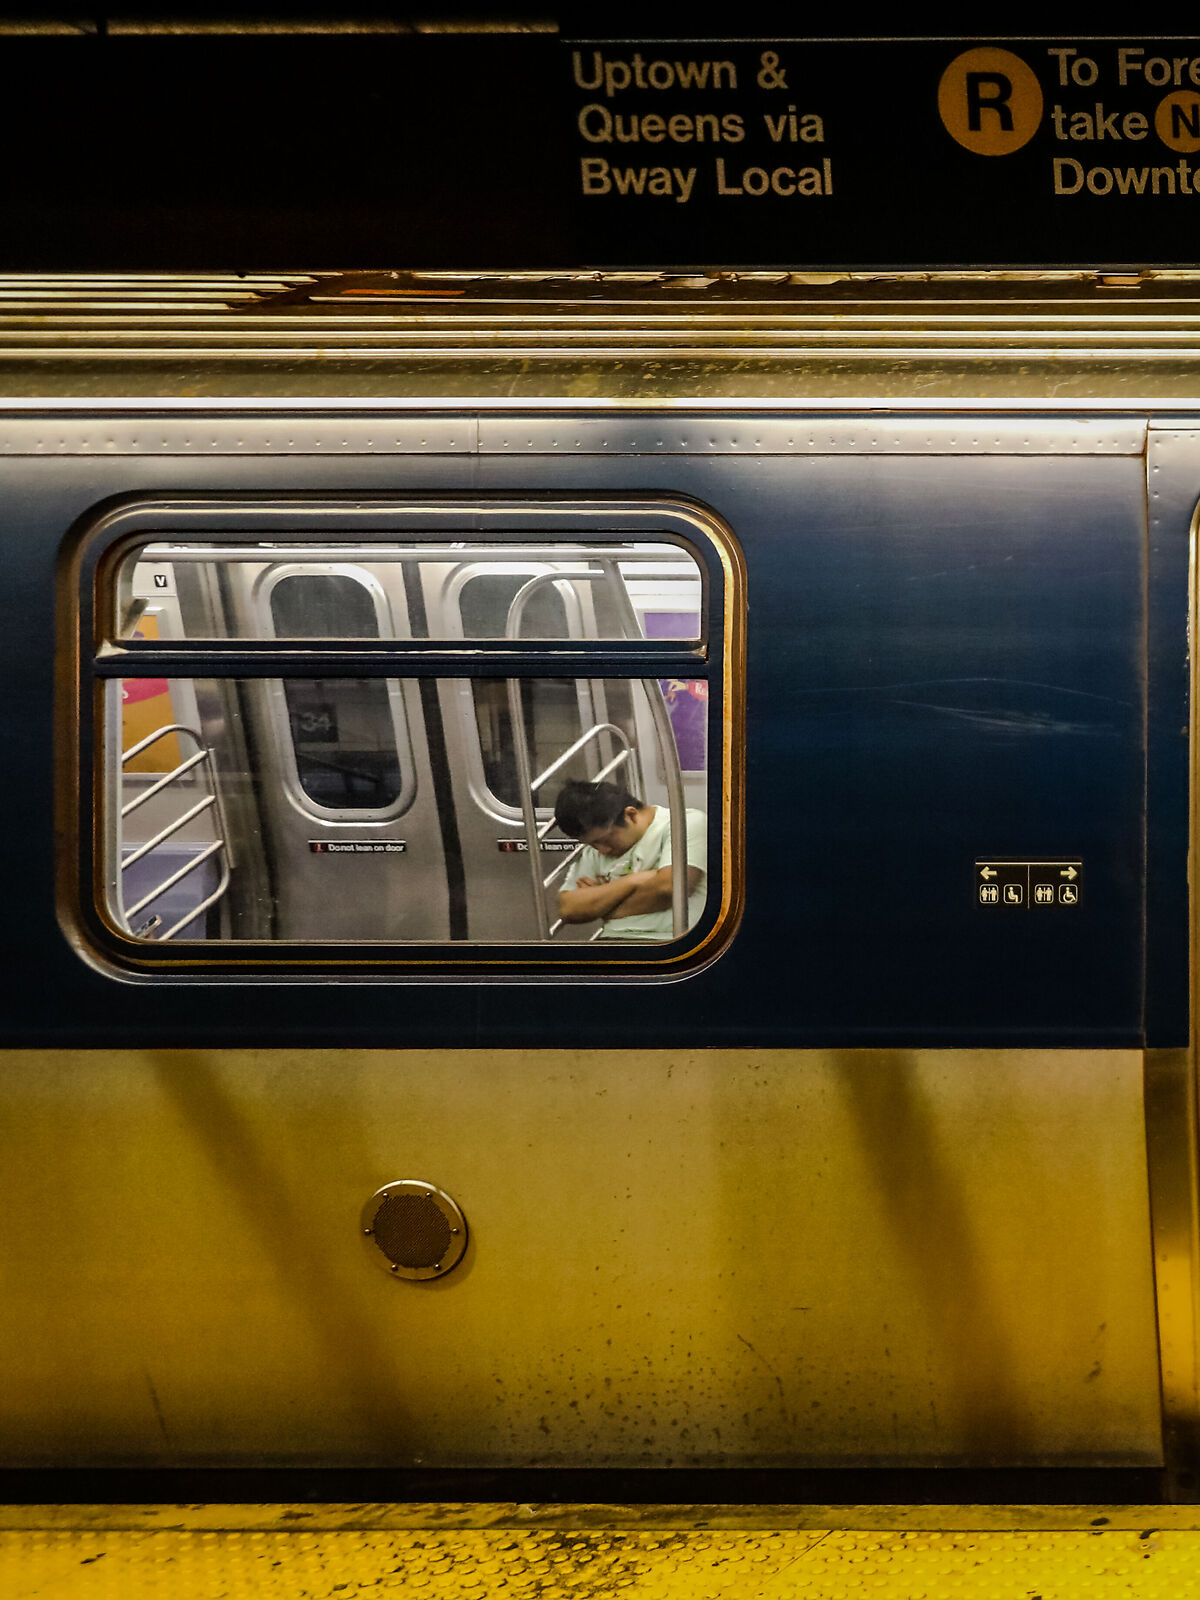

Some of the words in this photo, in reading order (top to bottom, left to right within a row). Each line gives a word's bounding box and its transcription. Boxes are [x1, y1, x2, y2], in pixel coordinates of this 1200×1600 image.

[572, 51, 738, 97] Uptown
[756, 50, 789, 90] &
[1047, 47, 1099, 87] To
[965, 70, 1014, 132] R
[578, 103, 745, 143] Queens
[763, 104, 825, 143] via
[1050, 102, 1148, 141] take
[1171, 104, 1200, 139] N
[580, 157, 697, 203] Bway
[716, 157, 833, 196] Local
[155, 575, 167, 587] V
